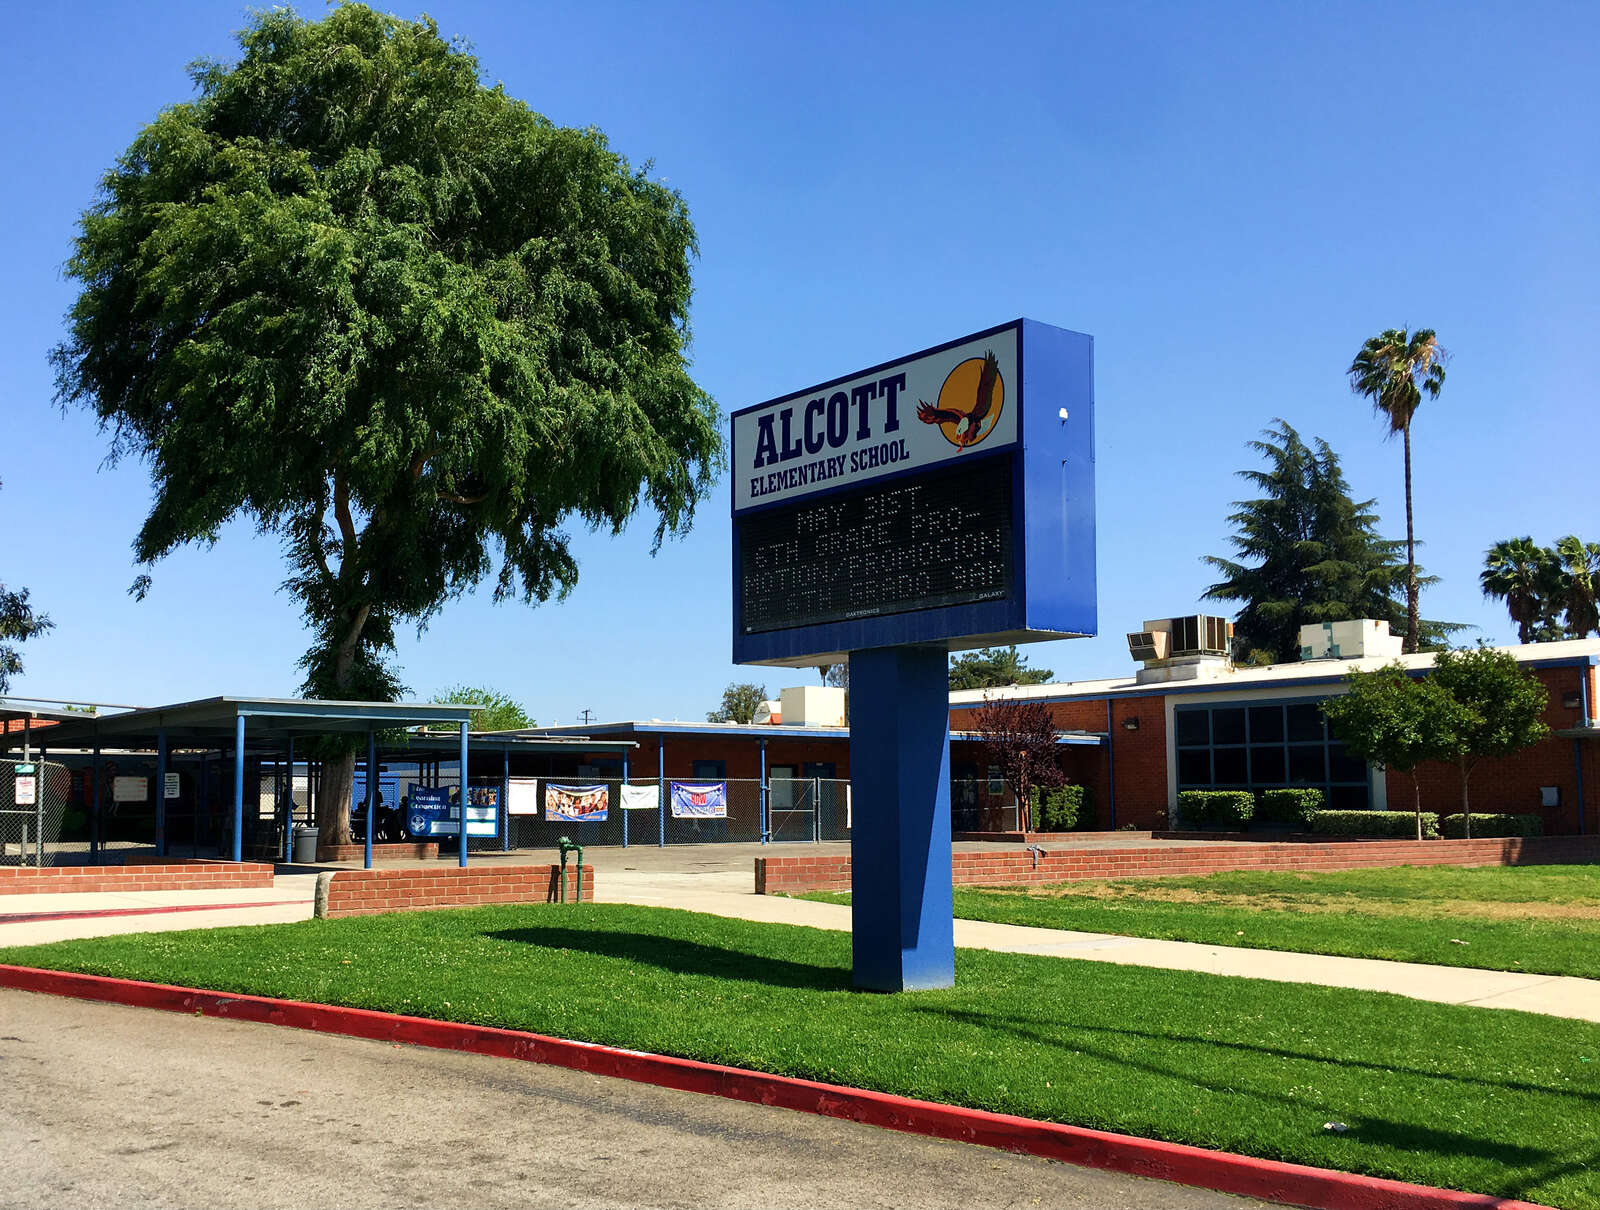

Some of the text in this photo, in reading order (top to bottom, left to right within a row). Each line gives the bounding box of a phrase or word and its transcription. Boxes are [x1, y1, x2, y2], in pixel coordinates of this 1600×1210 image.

[753, 372, 906, 469] ALCOTT
[750, 438, 910, 498] ELEMENTARY SCHOOL
[797, 502, 846, 534] MAY
[815, 520, 891, 557] GRADE
[979, 591, 1005, 599] GALAXY
